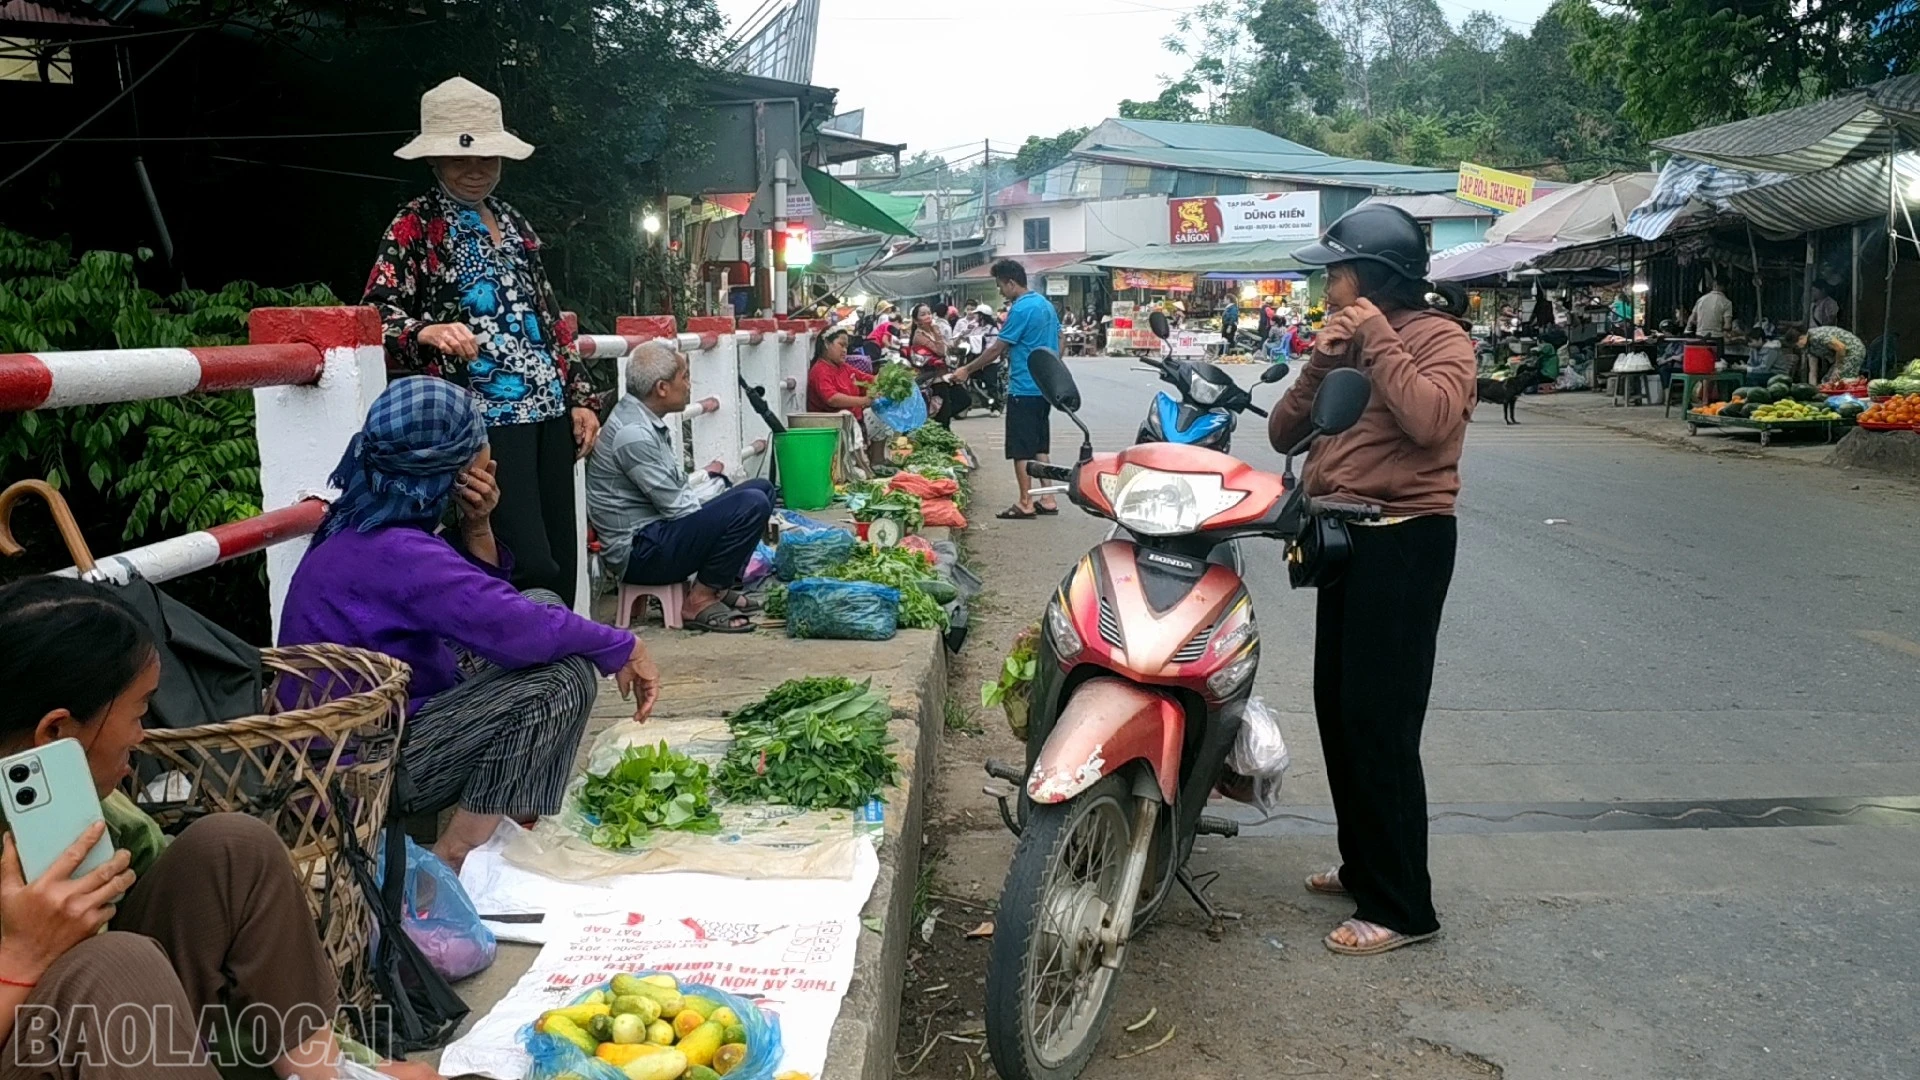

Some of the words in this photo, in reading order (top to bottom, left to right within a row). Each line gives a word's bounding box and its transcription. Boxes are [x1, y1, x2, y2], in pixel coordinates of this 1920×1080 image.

[1460, 174, 1474, 197] TẠP
[1244, 209, 1276, 220] DŨNG
[1148, 553, 1193, 569] HONDA
